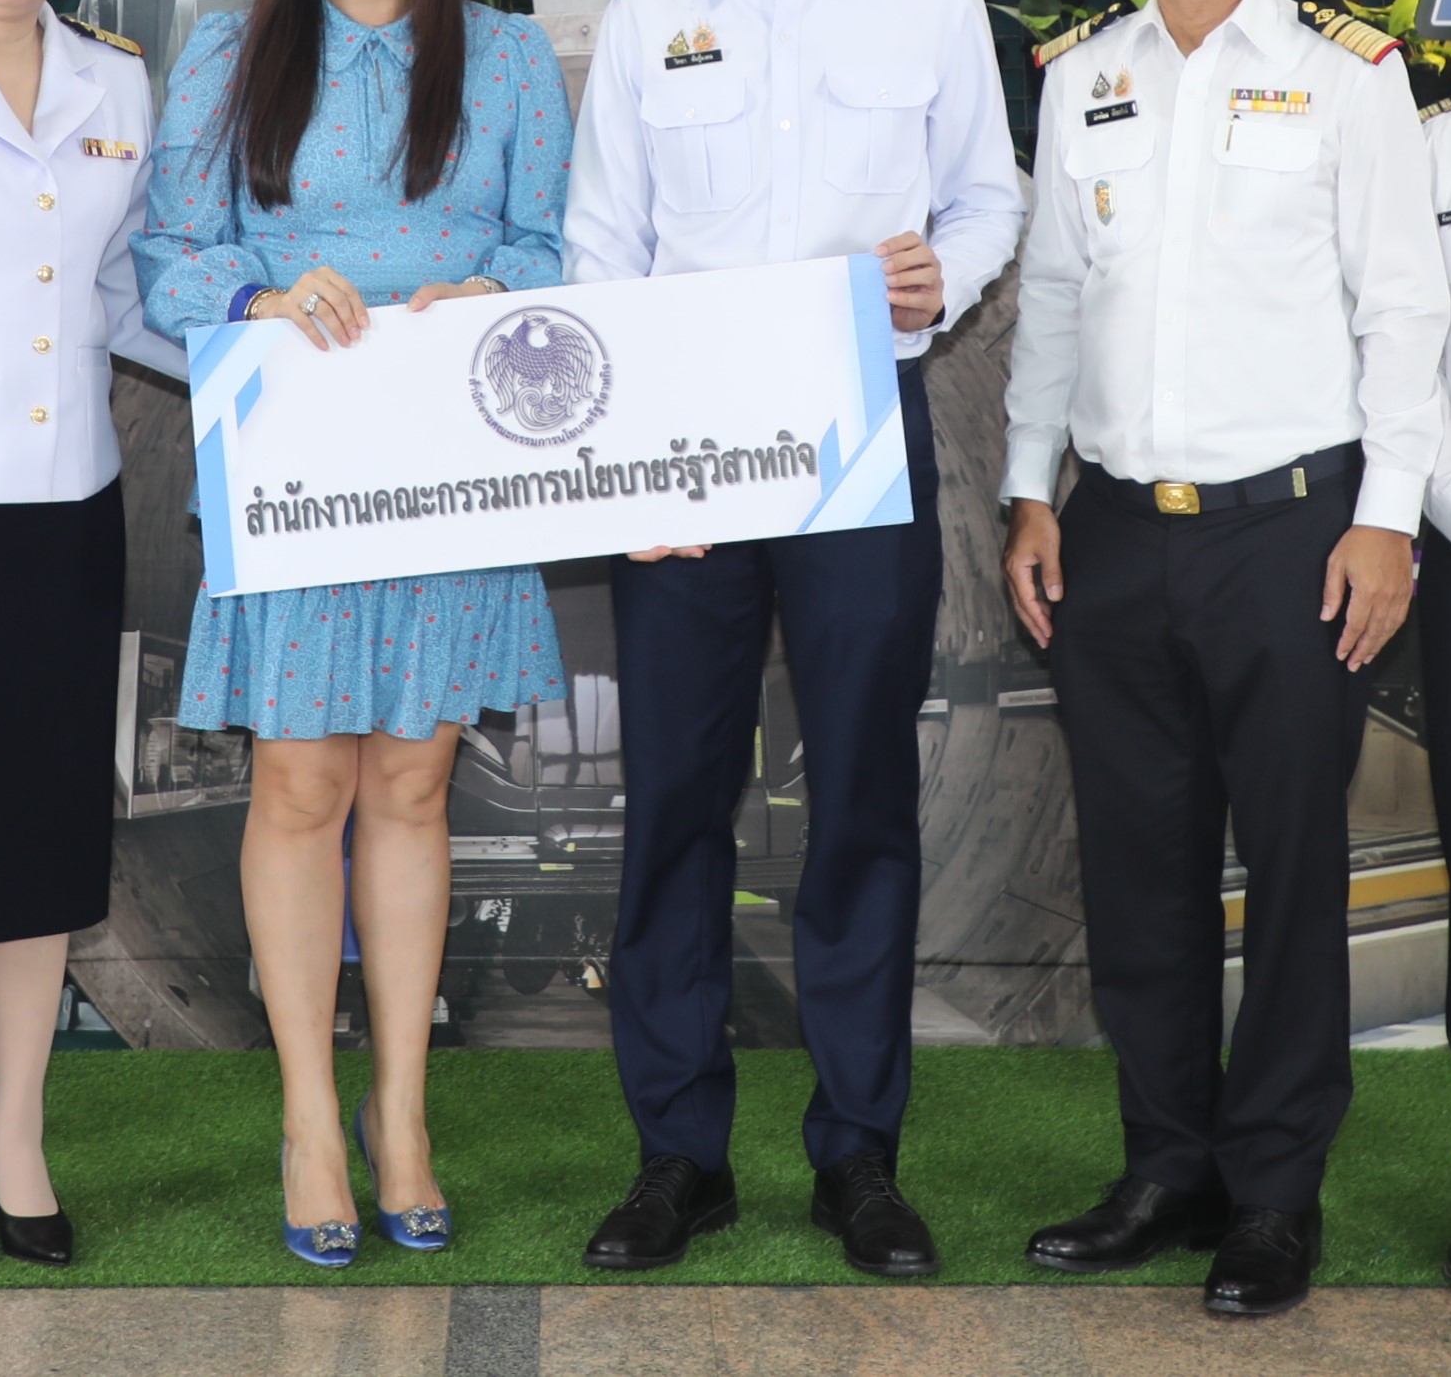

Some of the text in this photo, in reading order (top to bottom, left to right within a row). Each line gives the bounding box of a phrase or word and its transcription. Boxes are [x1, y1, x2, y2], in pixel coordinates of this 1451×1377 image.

[244, 428, 817, 536] สำนักงานคณะกรรมการนโยบายรัฐวิสาหกิจ
